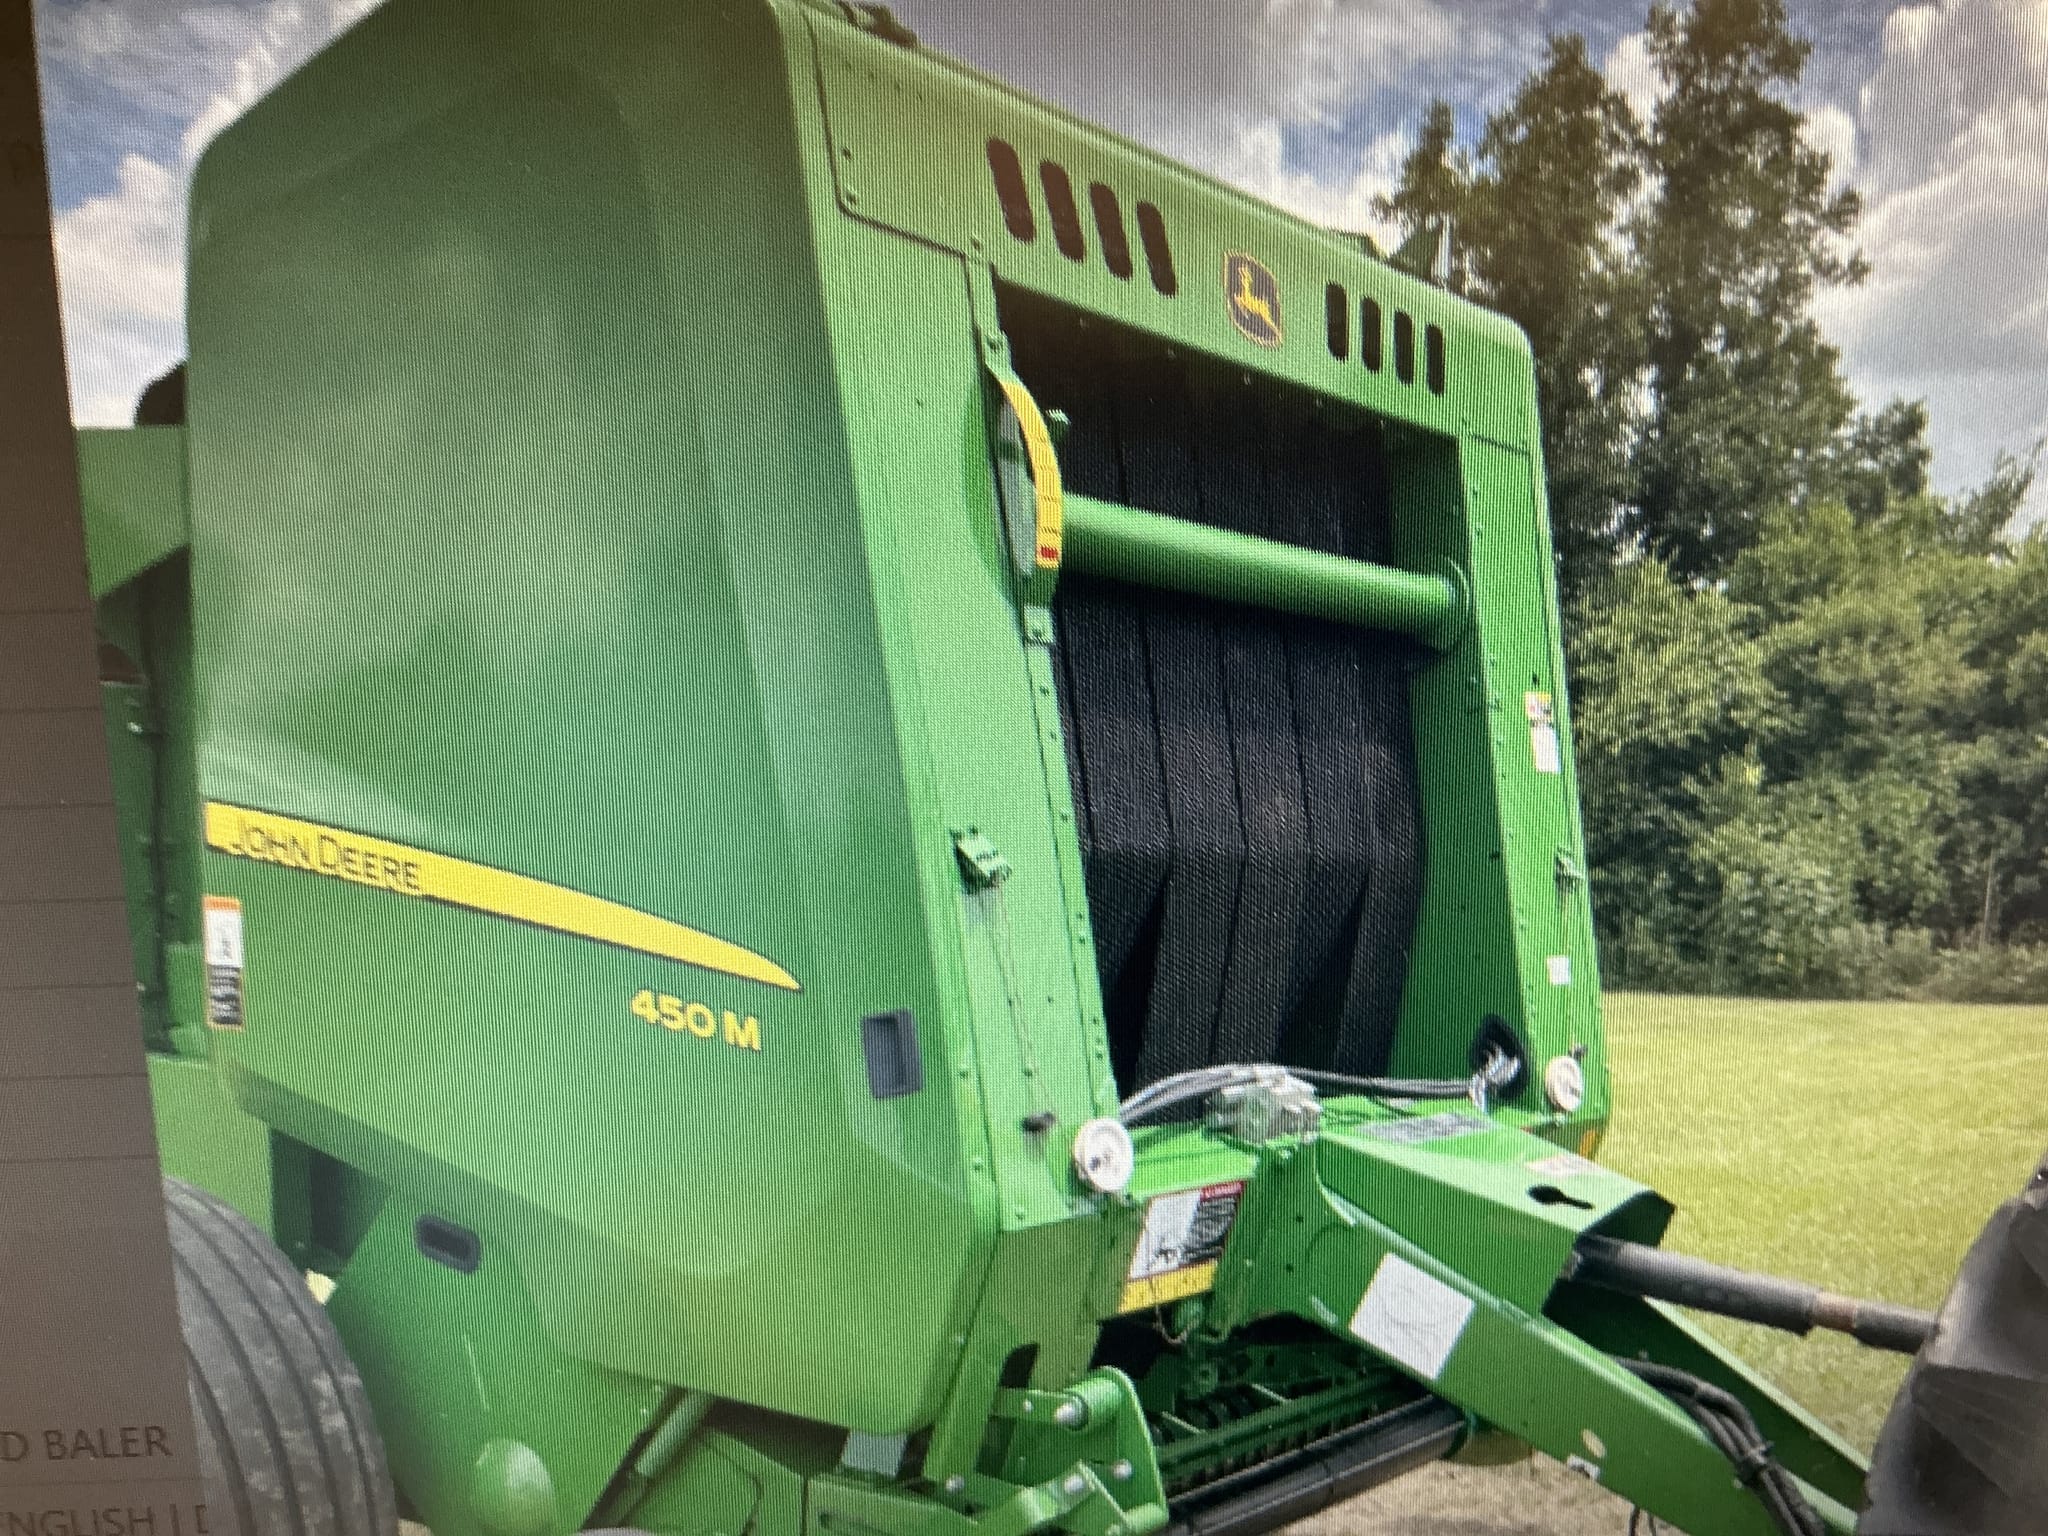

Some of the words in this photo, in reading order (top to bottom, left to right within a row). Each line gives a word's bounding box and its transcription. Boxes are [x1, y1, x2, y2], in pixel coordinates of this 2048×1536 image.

[229, 815, 311, 863] JOHN
[319, 833, 421, 890] DEERE
[631, 990, 717, 1039] 450
[723, 1010, 762, 1052] M
[44, 1426, 173, 1460] BALER
